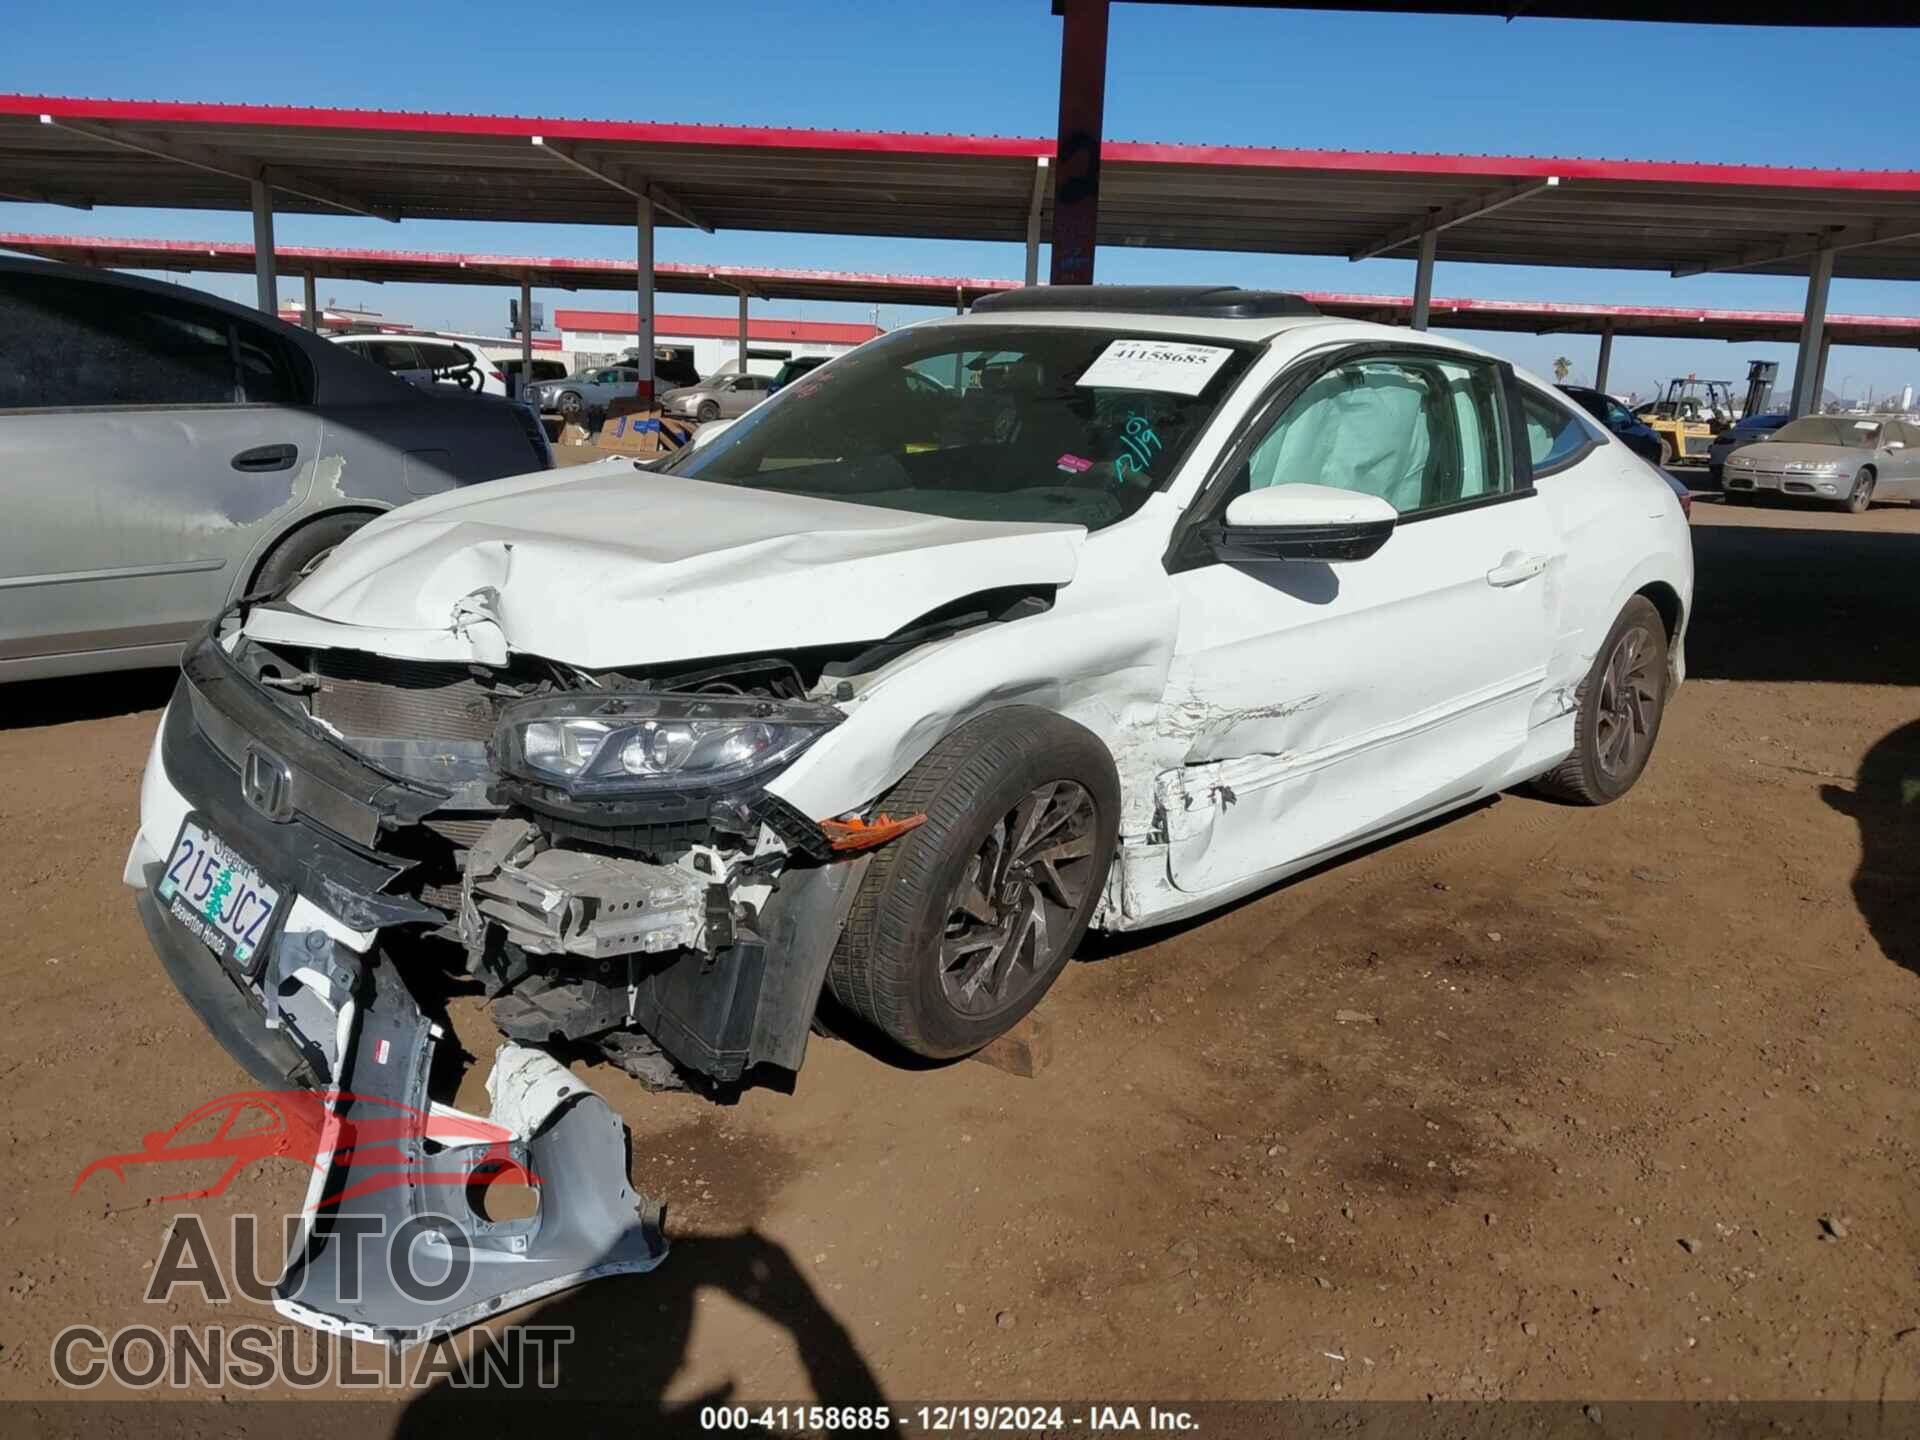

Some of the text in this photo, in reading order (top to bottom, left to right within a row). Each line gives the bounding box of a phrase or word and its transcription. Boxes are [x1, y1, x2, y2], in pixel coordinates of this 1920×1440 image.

[1114, 349, 1209, 365] 41158685
[168, 839, 273, 948] 215 JCZ
[170, 895, 206, 939] Beaverton
[201, 924, 227, 956] Honda
